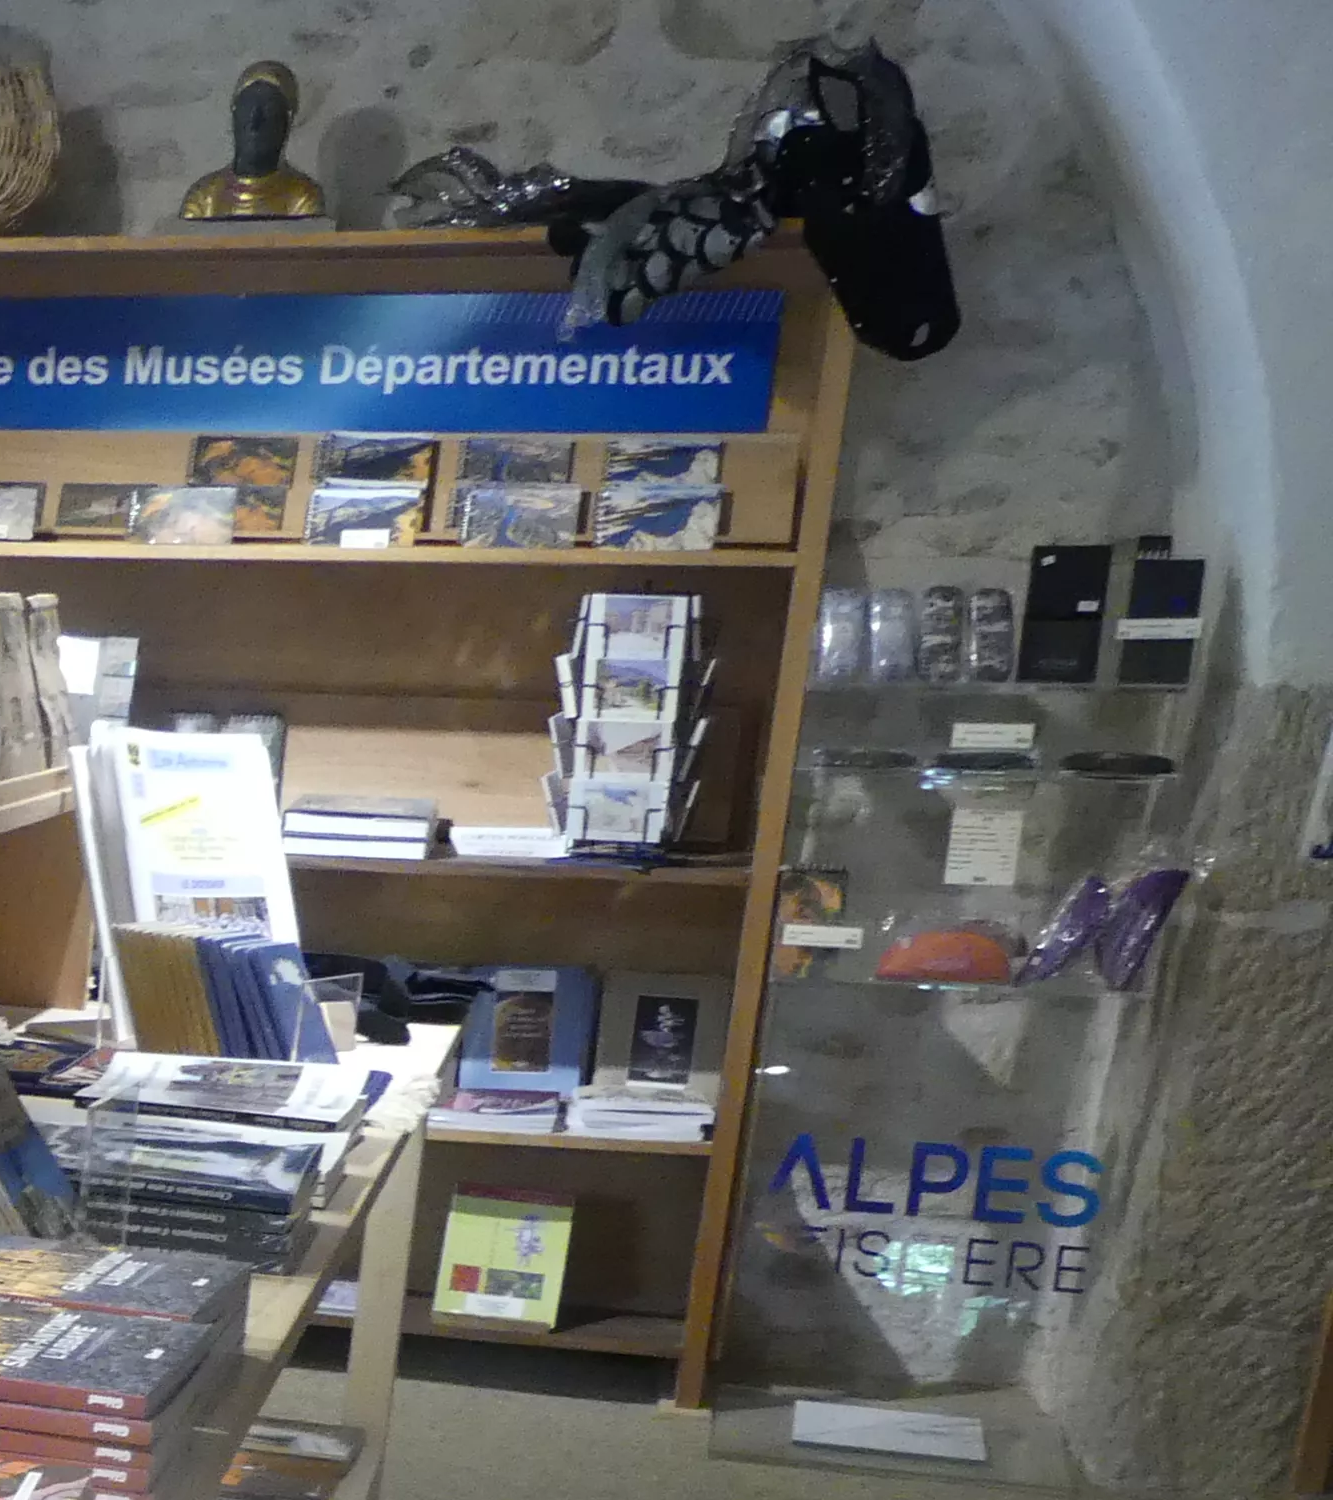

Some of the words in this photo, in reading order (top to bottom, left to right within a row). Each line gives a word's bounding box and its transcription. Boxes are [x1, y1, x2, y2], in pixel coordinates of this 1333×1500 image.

[27, 346, 109, 385] des
[123, 345, 303, 386] Musées
[319, 344, 735, 395] Départementaux
[768, 1133, 1105, 1228] ALPES
